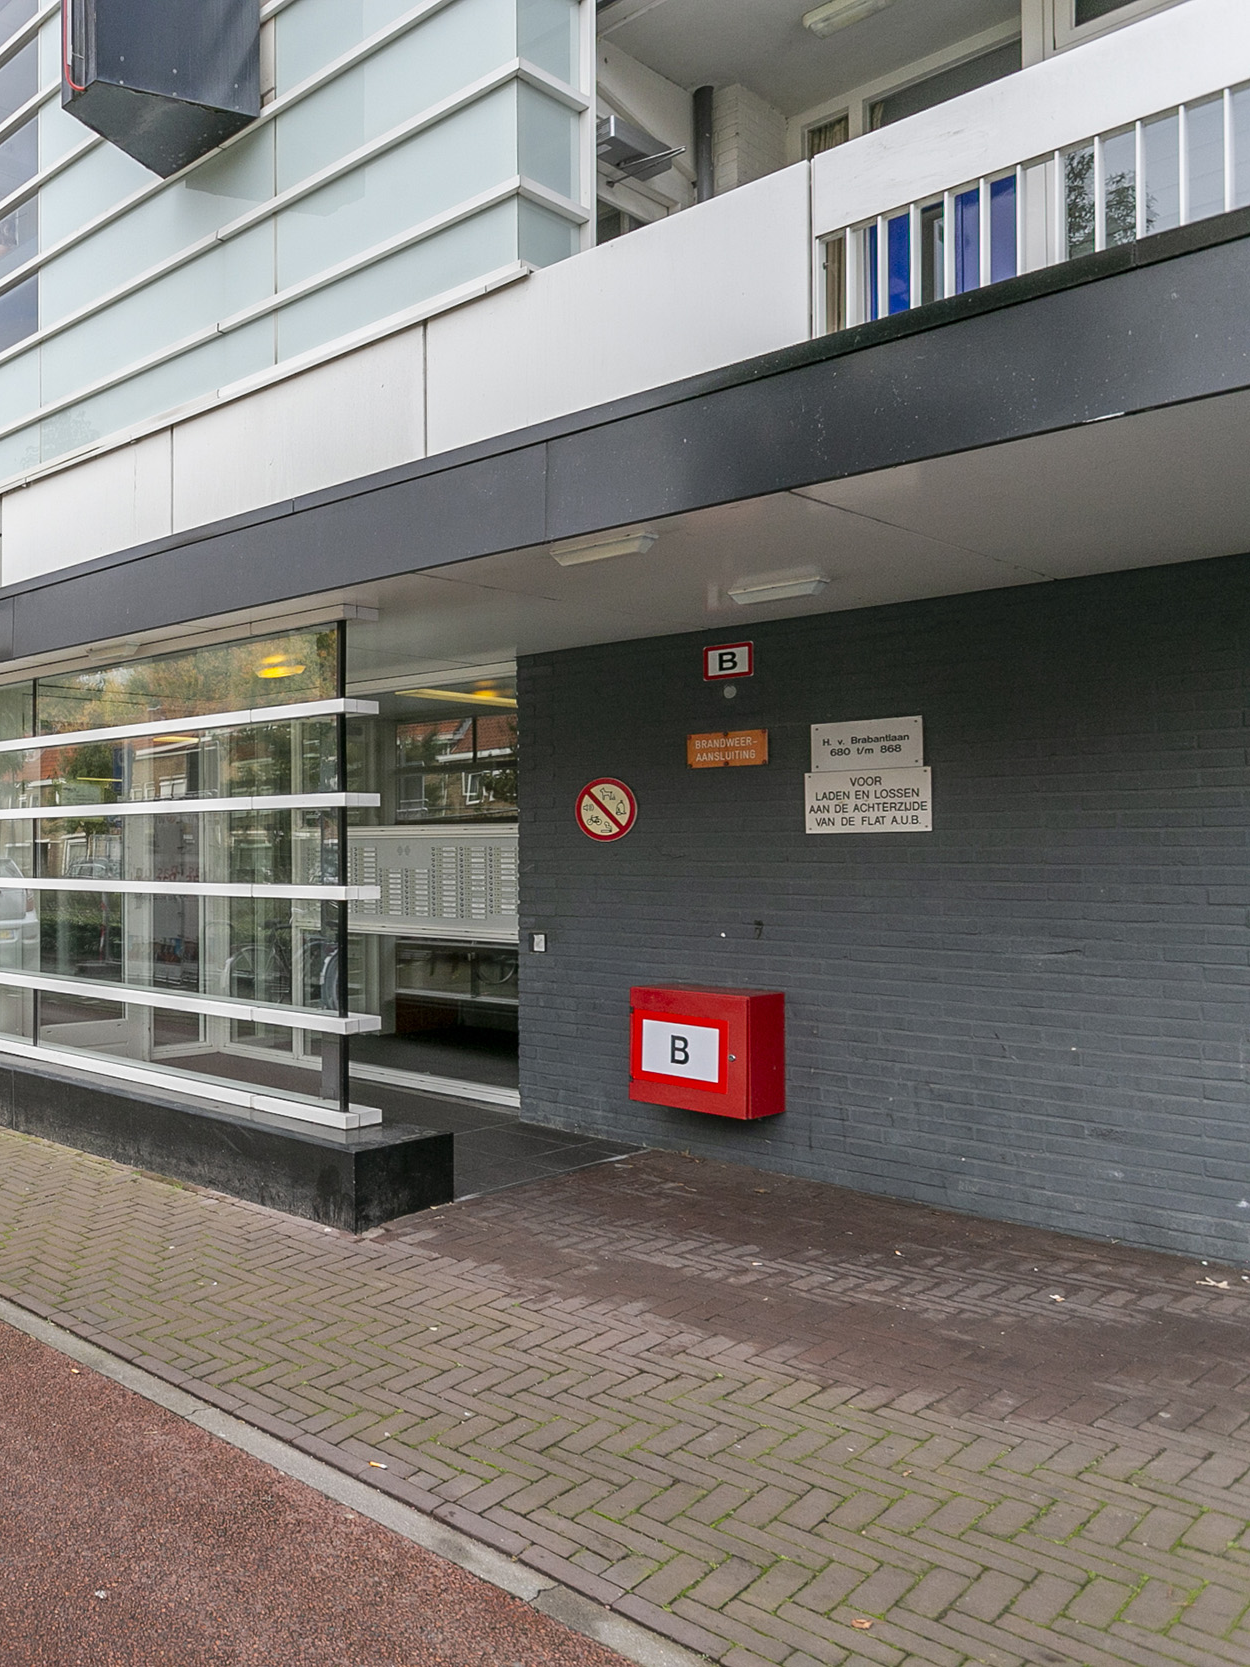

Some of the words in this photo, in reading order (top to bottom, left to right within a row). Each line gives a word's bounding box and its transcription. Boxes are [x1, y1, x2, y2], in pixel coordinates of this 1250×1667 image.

[718, 651, 738, 672] B
[695, 736, 758, 750] BRANDWEER-
[822, 738, 831, 746] H.
[850, 733, 910, 745] Brabantlaan
[695, 749, 756, 762] AANSLUITING
[830, 747, 851, 757] 680
[856, 746, 874, 755] t/m
[880, 743, 902, 754] 868
[849, 776, 882, 787] VOOR
[815, 790, 850, 801] LADEN
[854, 790, 870, 800] EN
[874, 787, 920, 799] LOSSEN
[809, 804, 830, 814] AAN
[834, 803, 849, 814] DE
[852, 800, 928, 813] ACHTERZIJDE
[815, 817, 835, 827] VAN
[841, 816, 855, 826] DE
[861, 815, 886, 826] FLAT
[890, 814, 921, 825] A.U.B.
[670, 1034, 690, 1065] B
